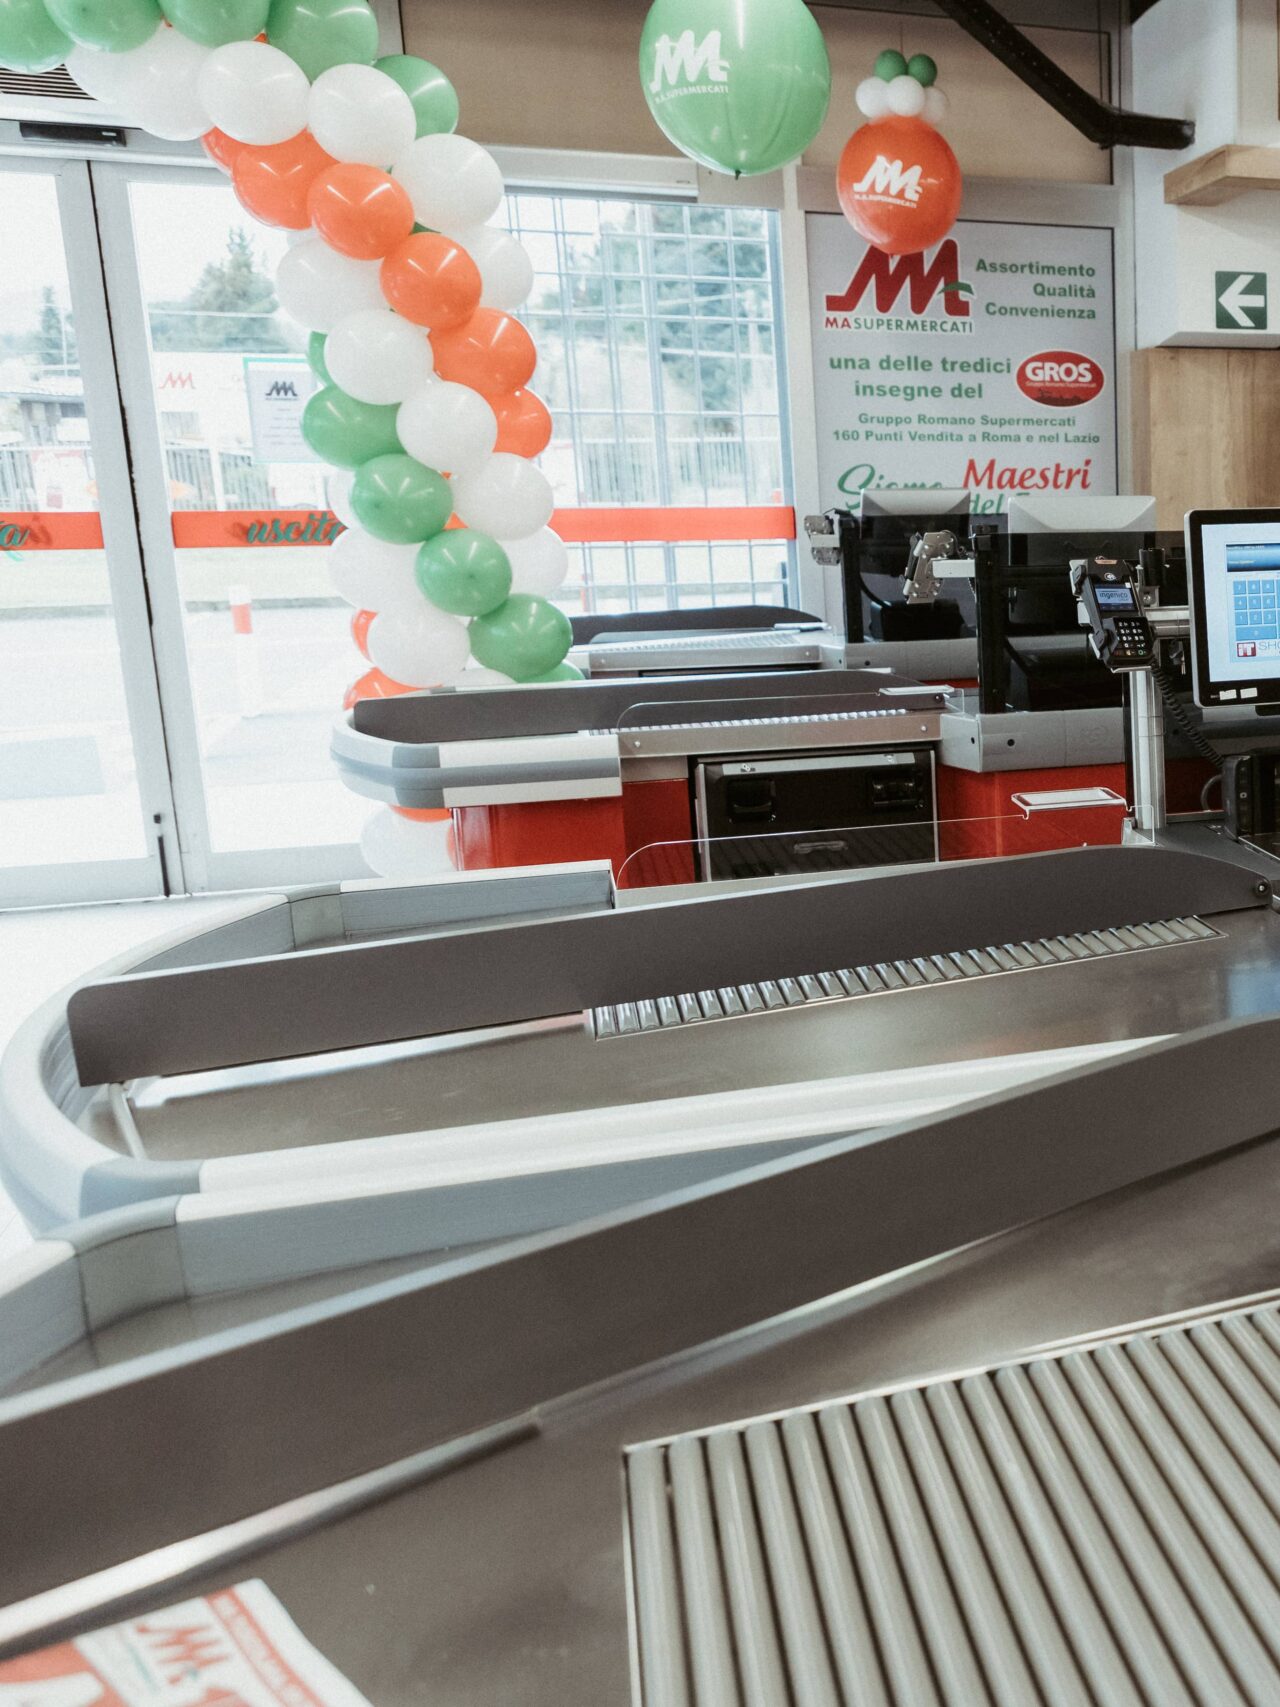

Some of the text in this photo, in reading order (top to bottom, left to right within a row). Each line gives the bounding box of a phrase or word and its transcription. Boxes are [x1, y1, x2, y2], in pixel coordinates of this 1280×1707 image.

[976, 258, 1096, 278] Assortimento
[1033, 282, 1096, 299] Qualità
[985, 302, 1096, 320] Convenienza
[829, 355, 1012, 374] una delle tredici
[1025, 362, 1093, 383] GROS
[854, 381, 983, 401] insegne del
[858, 413, 1076, 428] Gruppo Romano Supermercati
[833, 430, 1100, 443] 160 Punti Vendita a Roma e nel Lazio
[963, 459, 1092, 490] Maestri
